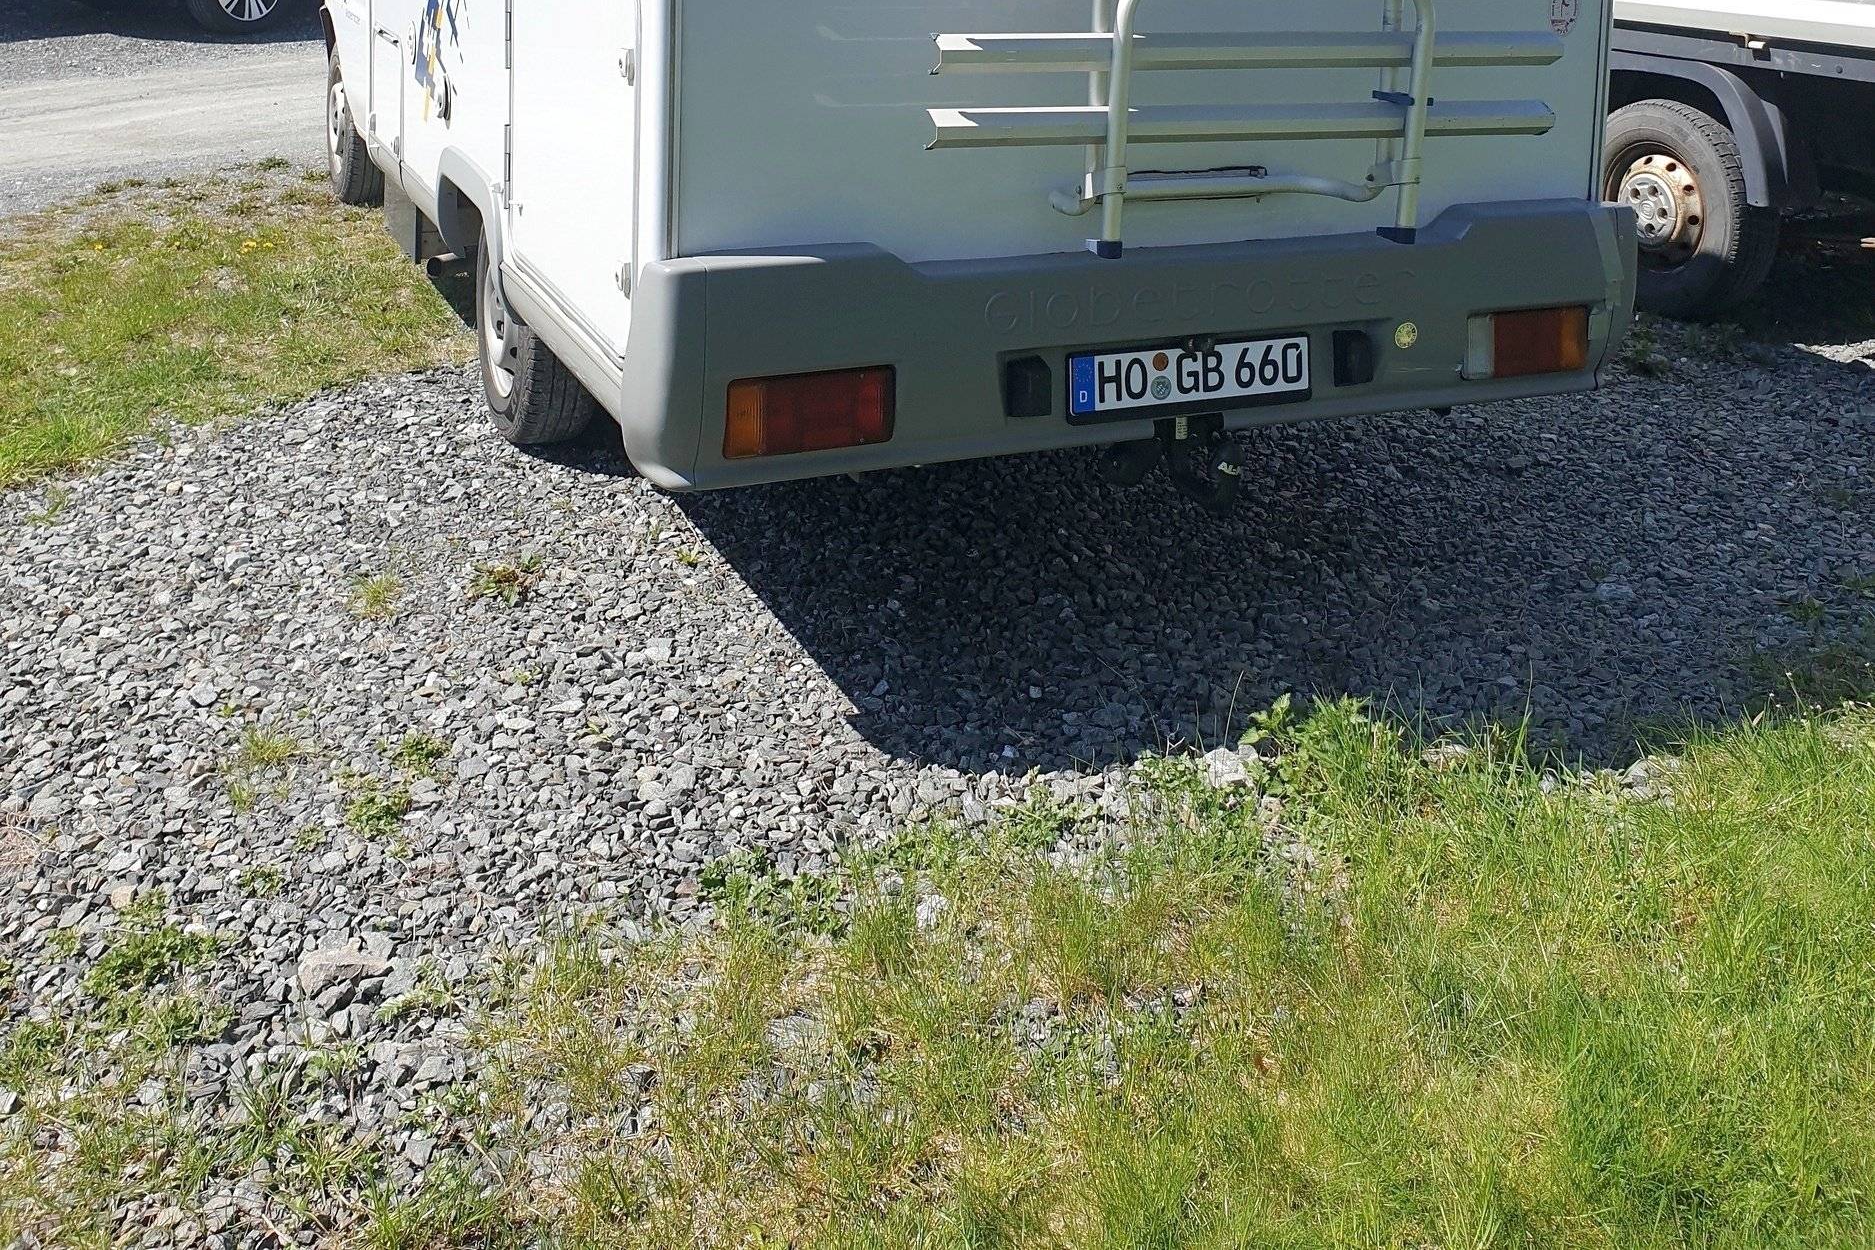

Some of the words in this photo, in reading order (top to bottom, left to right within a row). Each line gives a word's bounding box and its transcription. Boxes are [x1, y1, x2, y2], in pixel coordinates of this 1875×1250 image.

[1097, 357, 1148, 403] HO
[1177, 350, 1225, 395] GB
[1235, 342, 1303, 389] 660
[1079, 390, 1087, 403] D
